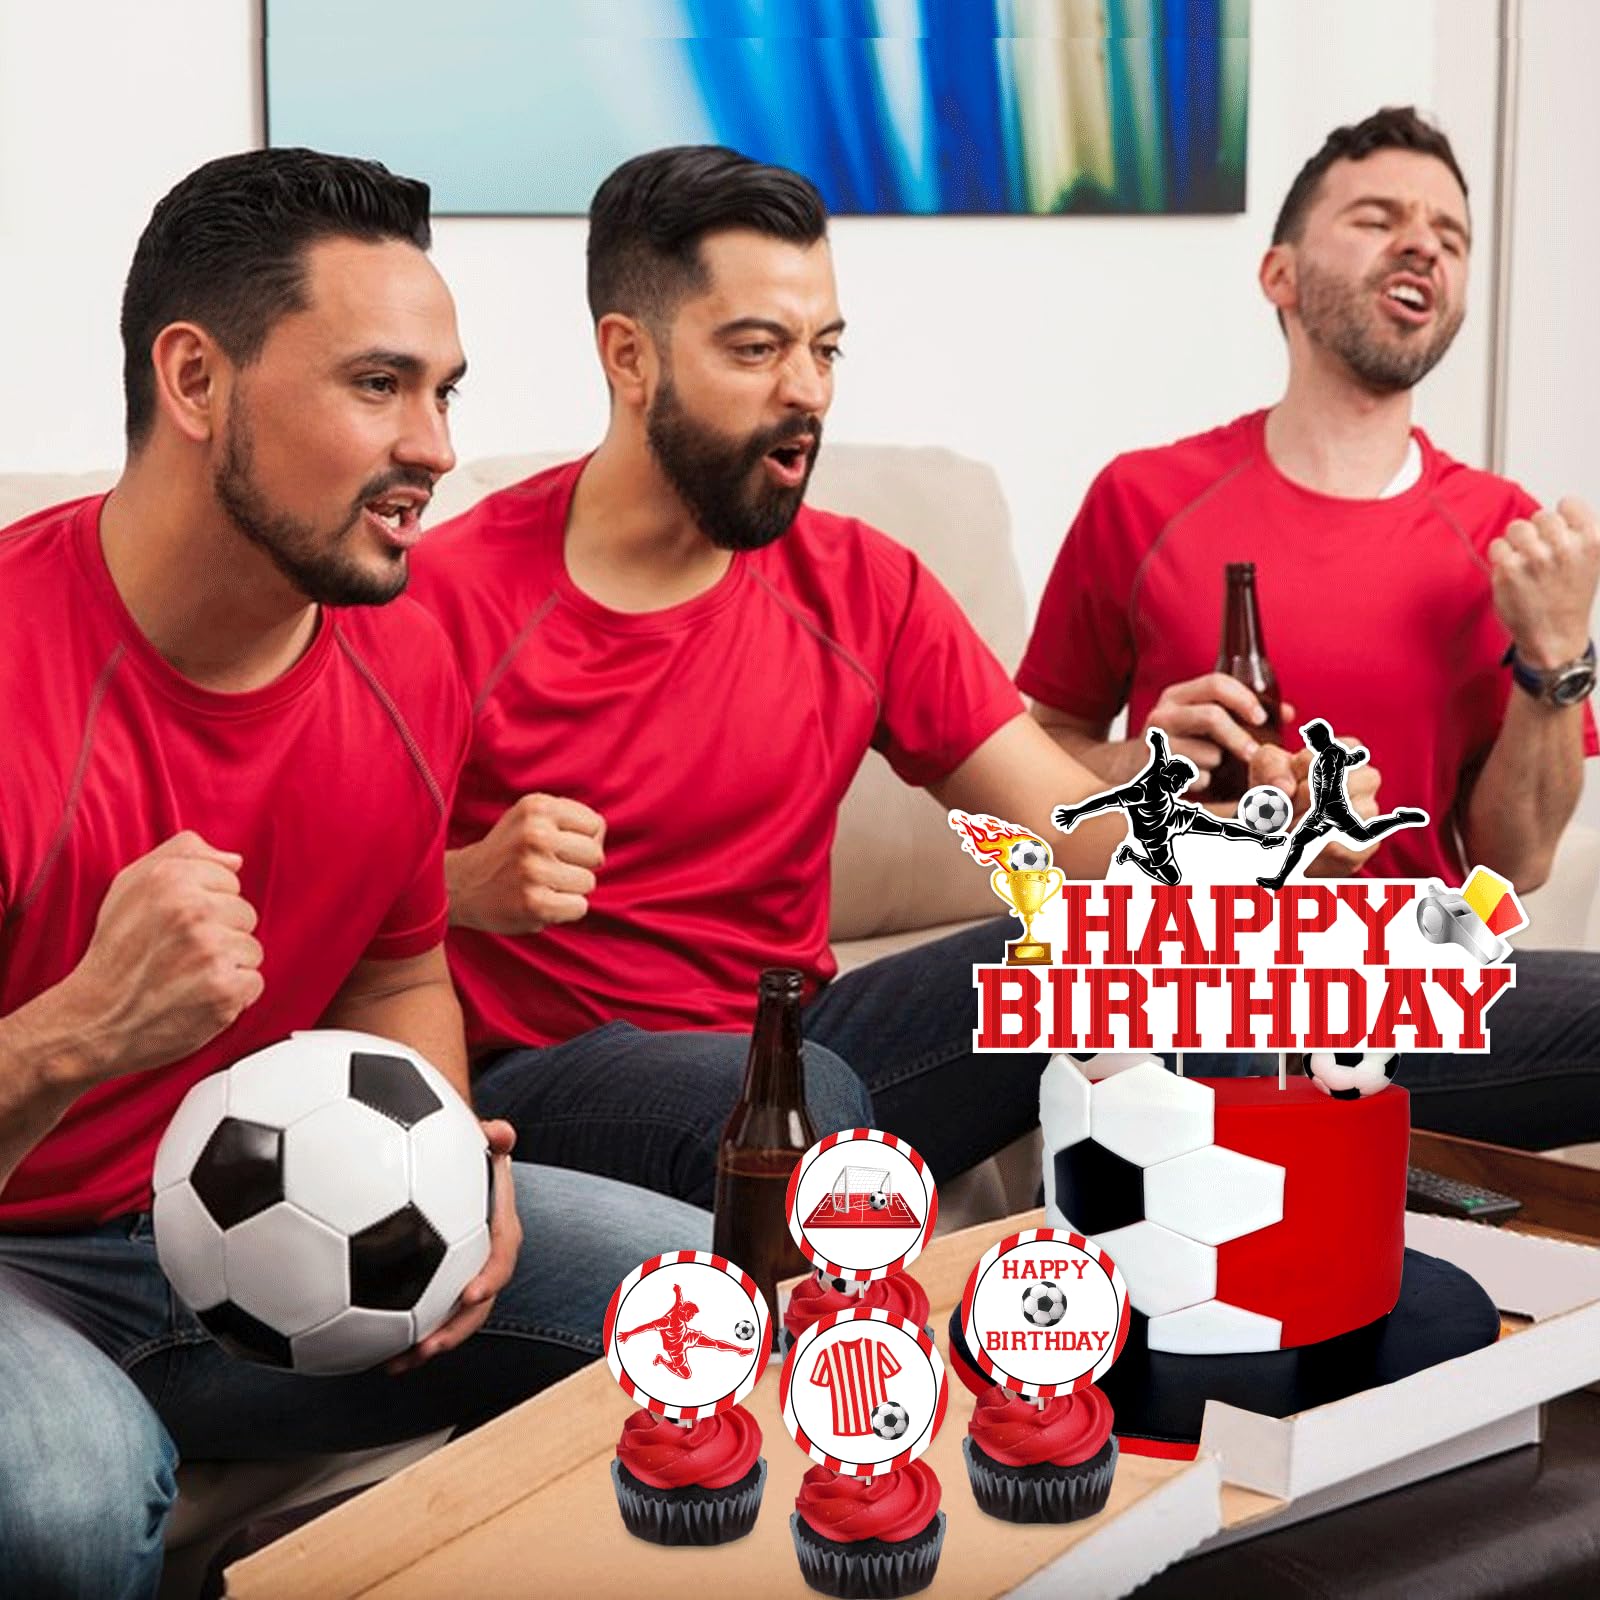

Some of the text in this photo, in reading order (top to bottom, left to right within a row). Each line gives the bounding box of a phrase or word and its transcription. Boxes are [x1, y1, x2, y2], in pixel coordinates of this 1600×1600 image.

[1061, 884, 1416, 965] HAPPY
[977, 967, 1511, 1048] BIRTHDAY
[1002, 1259, 1089, 1279] HAPPY
[986, 1331, 1110, 1351] BIRTHDAY
